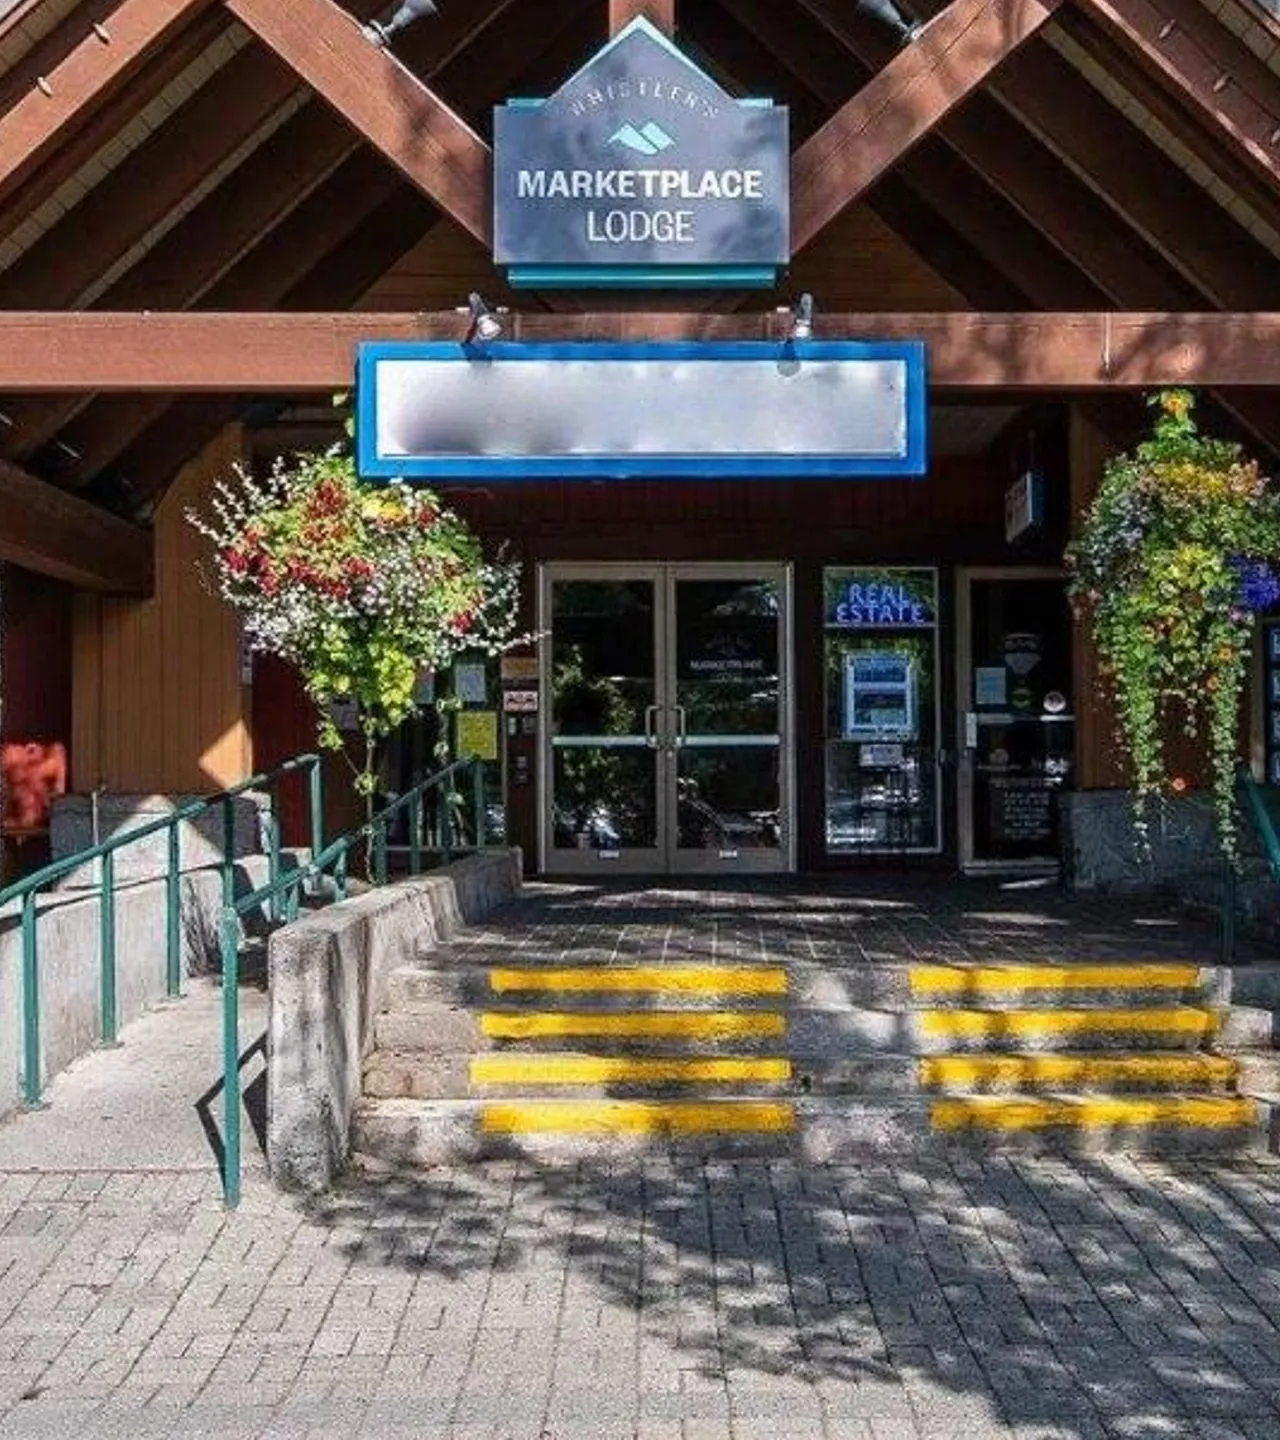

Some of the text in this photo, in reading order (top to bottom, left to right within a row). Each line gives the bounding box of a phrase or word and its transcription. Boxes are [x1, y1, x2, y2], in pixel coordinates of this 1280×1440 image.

[517, 169, 764, 198] MARKETPLACE
[587, 211, 695, 242] LODGE
[848, 582, 911, 605] REAL
[836, 604, 925, 624] ESTATE
